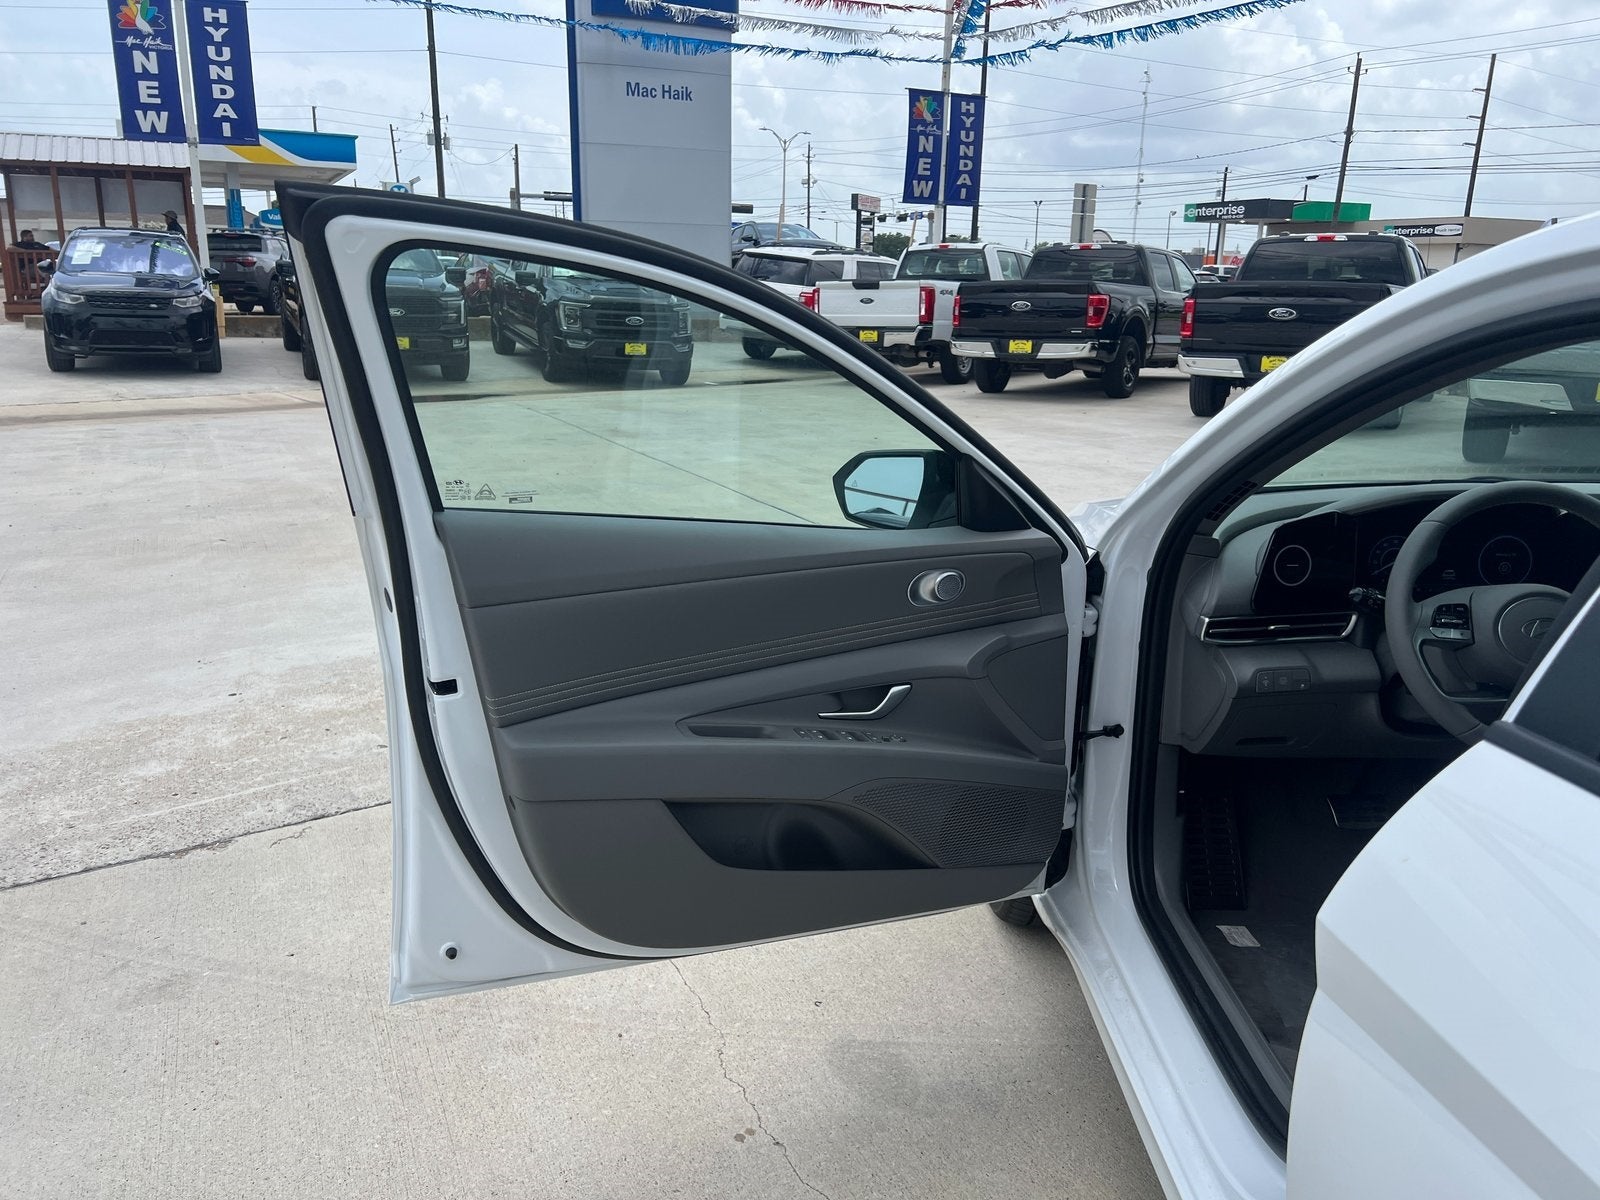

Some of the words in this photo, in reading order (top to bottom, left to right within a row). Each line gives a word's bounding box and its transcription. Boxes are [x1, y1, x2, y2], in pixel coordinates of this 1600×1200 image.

[132, 50, 169, 134] NEW
[202, 6, 239, 137] HYUNDAI
[625, 81, 657, 99] Mac
[661, 84, 693, 102] Haik
[912, 135, 934, 198] NEW
[956, 101, 976, 200] HYUNDAI
[1184, 203, 1246, 218] enterprise
[1386, 226, 1434, 236] enterprise
